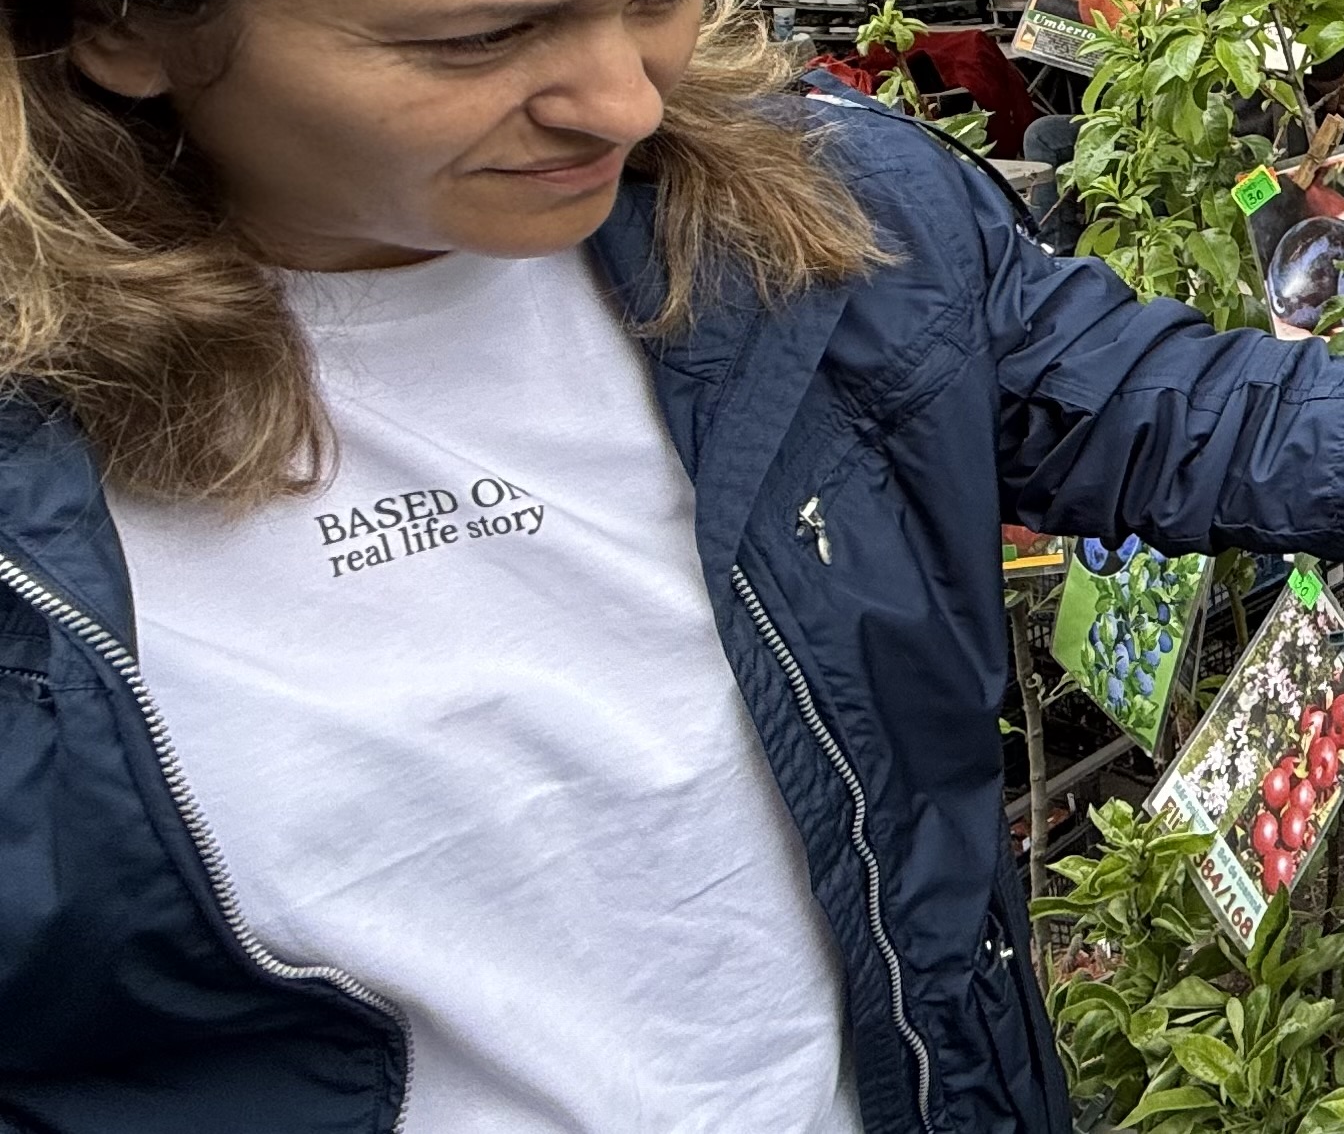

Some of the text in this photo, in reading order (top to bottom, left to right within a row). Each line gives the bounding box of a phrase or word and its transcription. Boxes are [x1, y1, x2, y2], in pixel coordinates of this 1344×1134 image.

[1032, 12, 1097, 40] Umberto
[1248, 190, 1264, 206] 30
[314, 488, 458, 546] BASED
[328, 504, 545, 578] real life story
